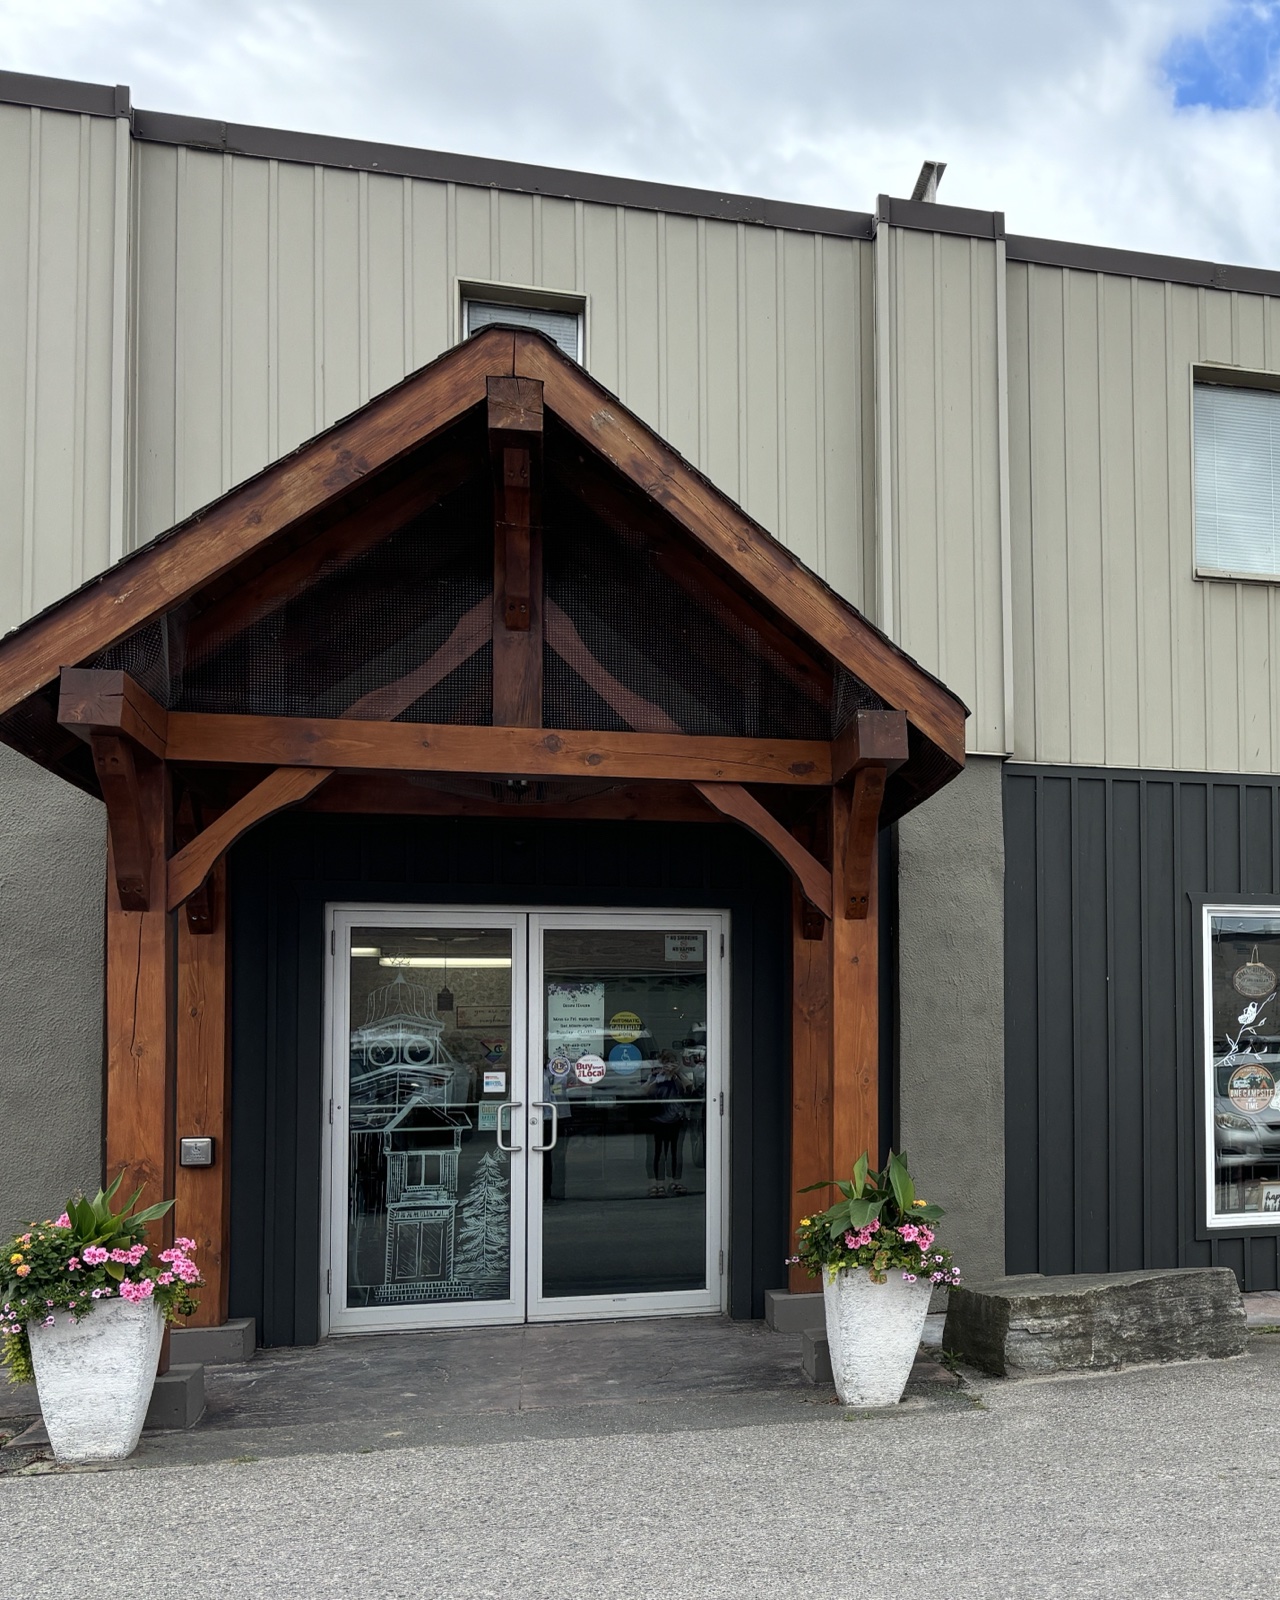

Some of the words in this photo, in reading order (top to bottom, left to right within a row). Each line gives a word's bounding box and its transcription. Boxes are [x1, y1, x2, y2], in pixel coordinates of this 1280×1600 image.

[576, 1062, 593, 1071] Buy
[582, 1069, 605, 1078] Local
[1230, 1088, 1242, 1097] ONE
[1242, 1088, 1274, 1097] CAMPSITE
[1245, 1102, 1259, 1110] TIME
